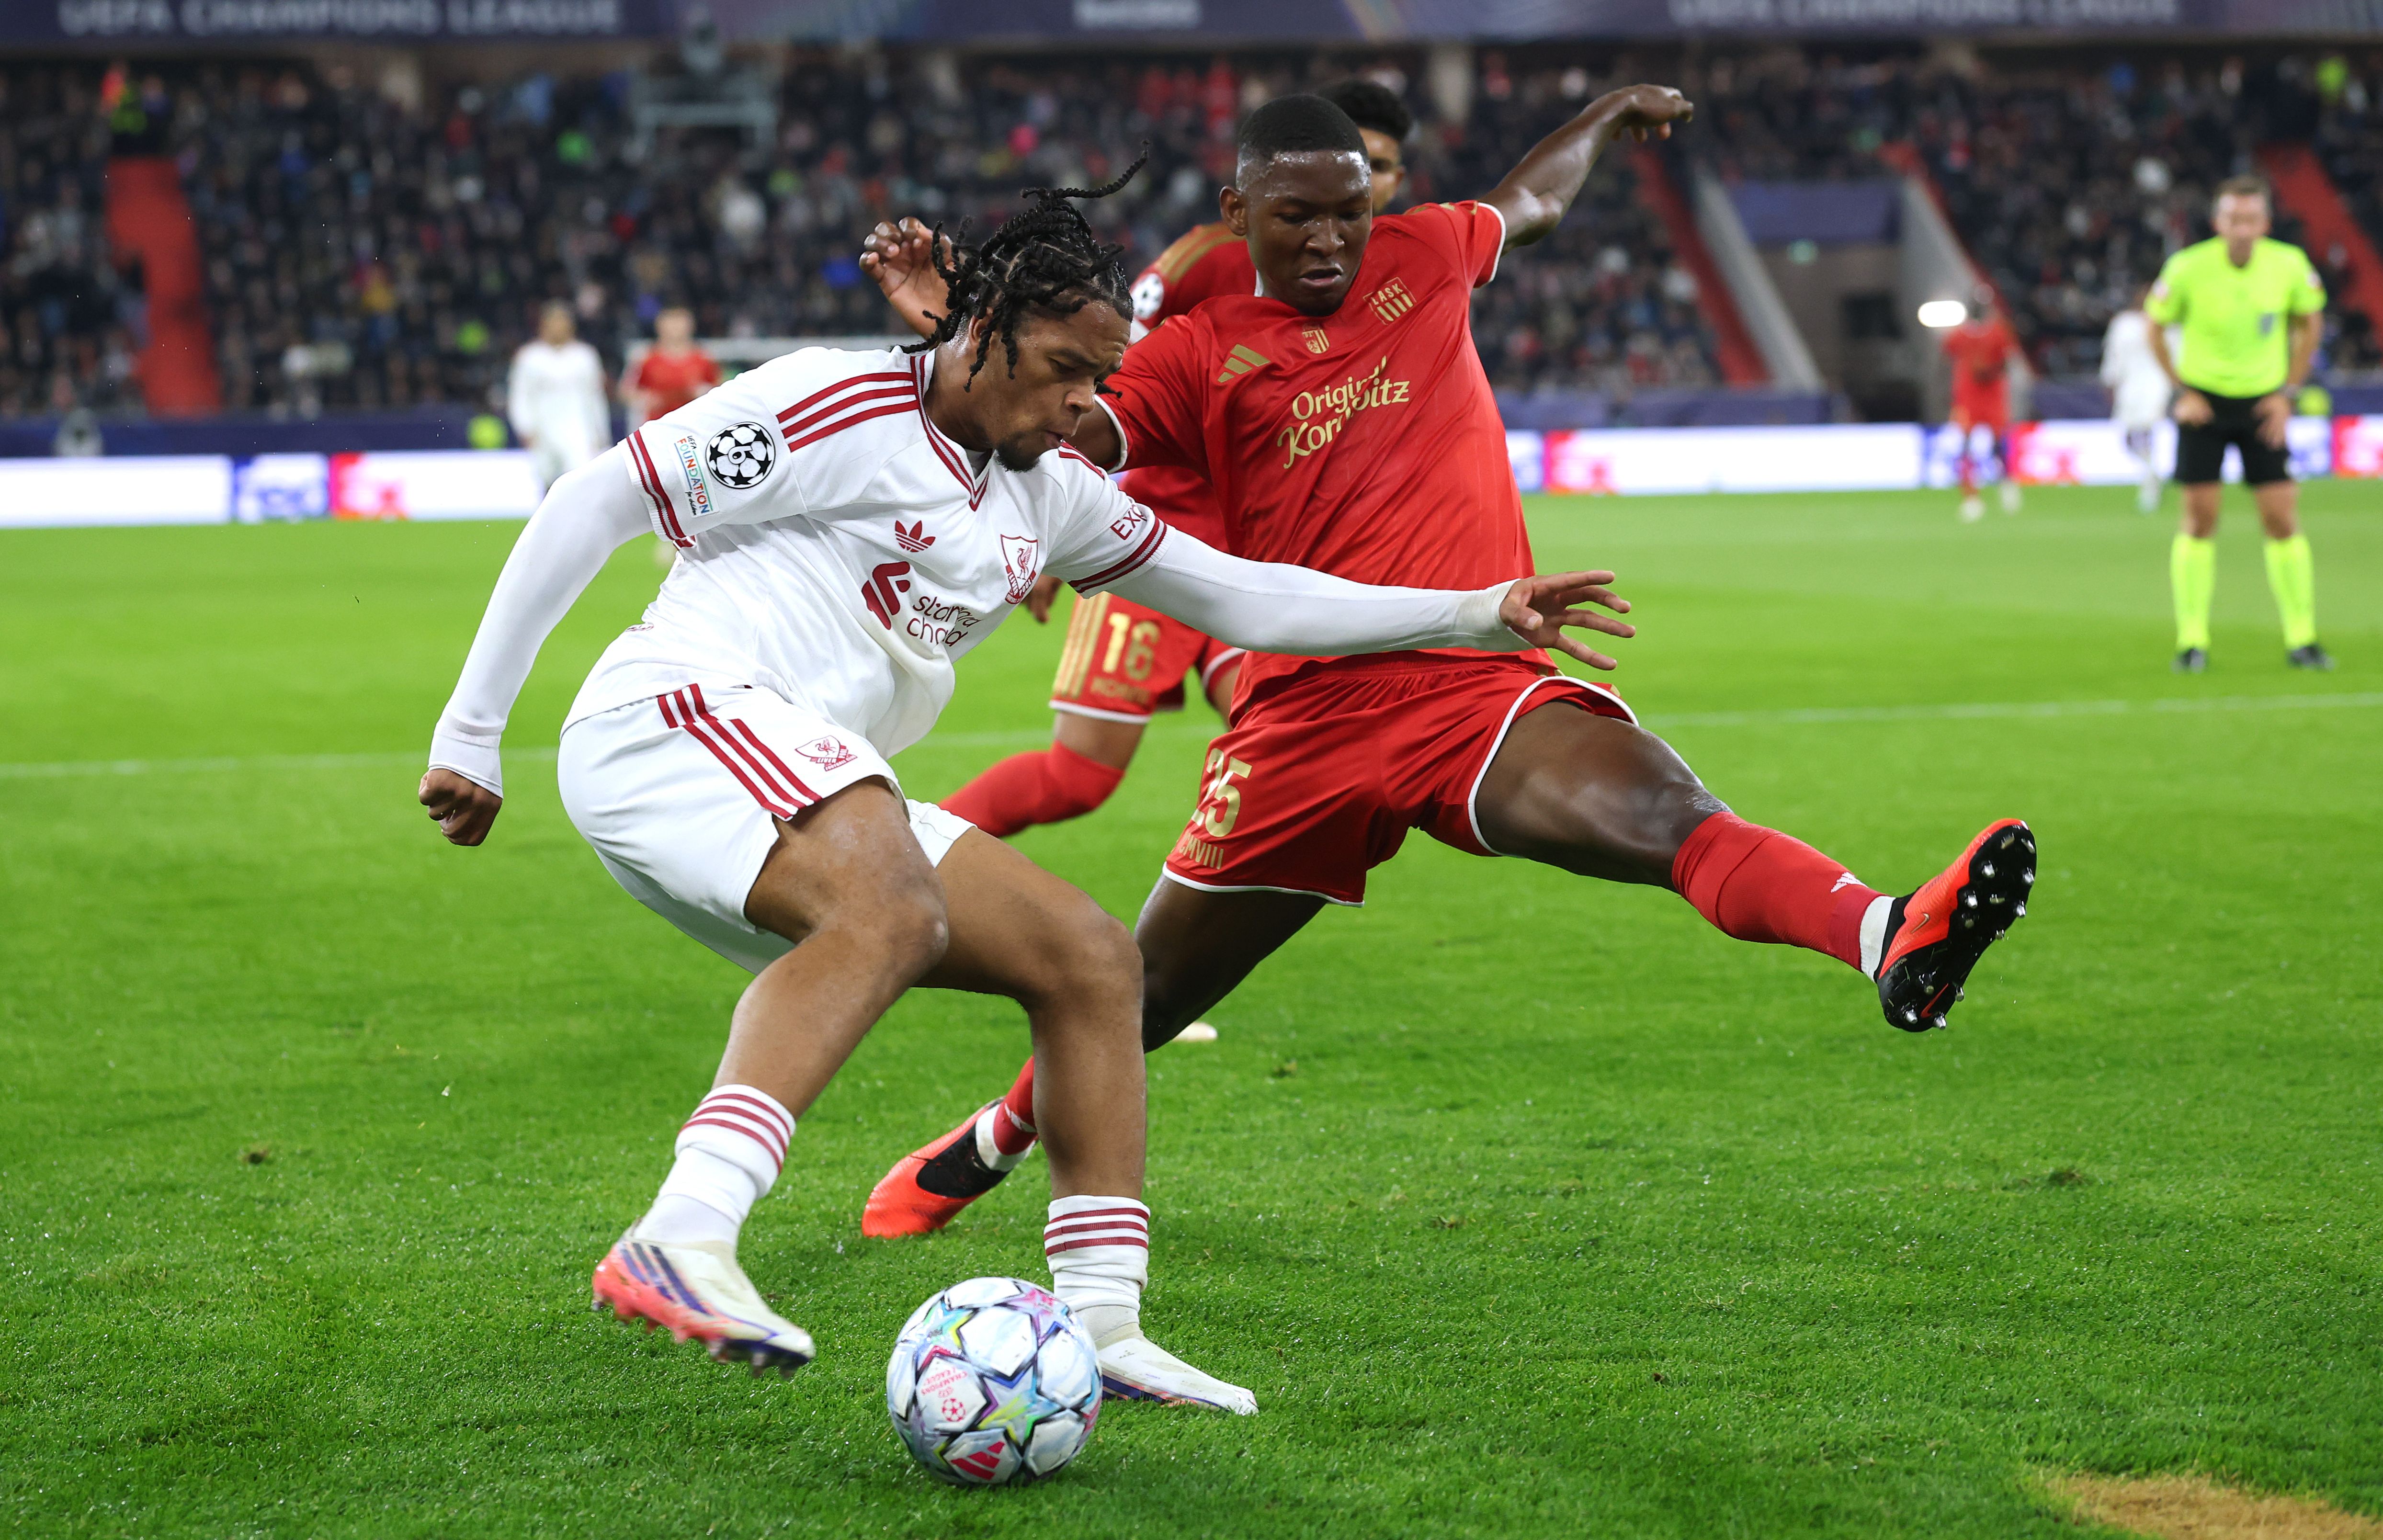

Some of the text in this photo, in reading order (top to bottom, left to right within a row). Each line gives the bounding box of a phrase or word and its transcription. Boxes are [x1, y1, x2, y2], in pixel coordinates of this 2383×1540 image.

[1371, 283, 1403, 305] LASK
[1292, 355, 1387, 420] Origil
[687, 435, 696, 450] UEFA
[1277, 377, 1410, 469] Koritz
[689, 498, 697, 516] children
[1103, 612, 1161, 681] 16
[1191, 747, 1253, 838] 25
